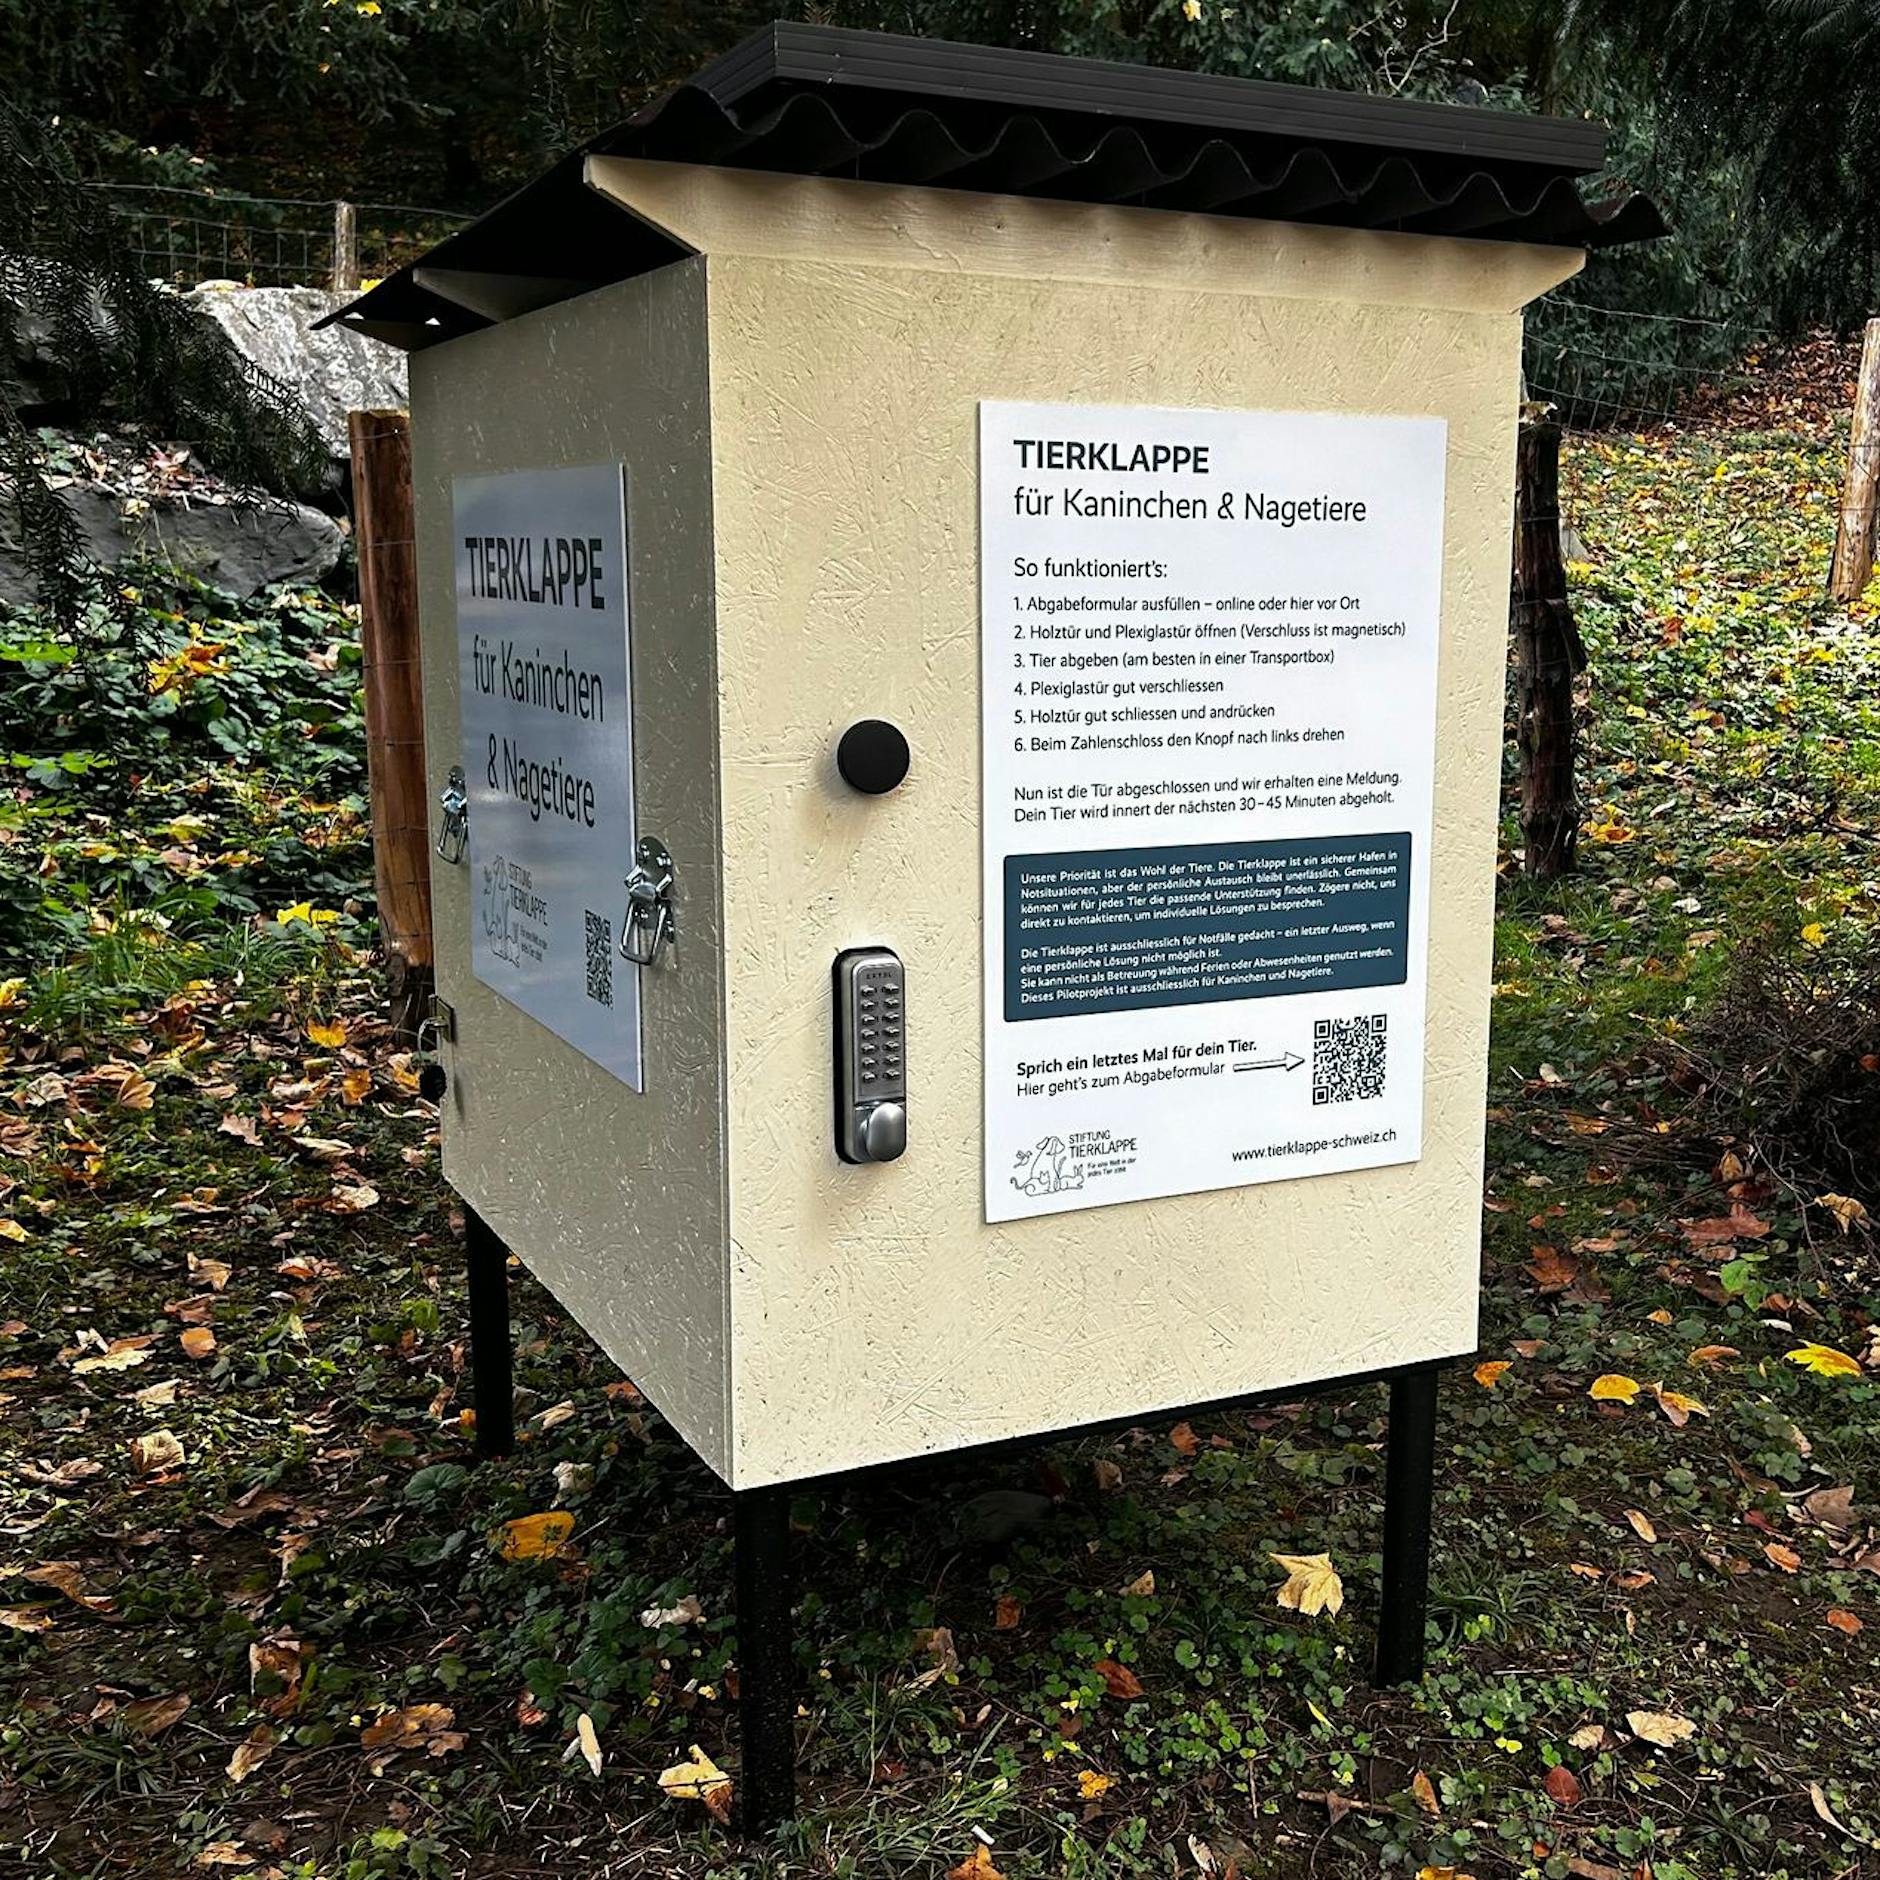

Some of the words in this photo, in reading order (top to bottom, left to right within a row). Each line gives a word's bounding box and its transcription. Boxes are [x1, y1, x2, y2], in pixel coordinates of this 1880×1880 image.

[1013, 439, 1209, 474] TIERKLAPPE
[1014, 485, 1053, 516] für
[1064, 488, 1206, 519] Kaninchen
[1217, 491, 1234, 519] &
[1245, 492, 1366, 527] Nagetiere
[465, 537, 605, 610] TIERKLAPPE
[1014, 557, 1038, 576] So
[1013, 596, 1023, 611] 1.
[1026, 595, 1137, 615] Abgabeformular
[1141, 595, 1200, 611] ausfüllen
[1215, 596, 1255, 610] online
[1258, 596, 1287, 610] oder
[1290, 596, 1314, 610] hier
[1316, 599, 1337, 610] vor
[1340, 596, 1360, 610] Ort
[1014, 624, 1025, 639] 2.
[1030, 624, 1081, 639] Holztür
[1085, 624, 1111, 639] und
[1115, 623, 1191, 642] Plexiglastür
[1194, 623, 1236, 638] öffnen
[1240, 623, 1310, 639] (Verschluss
[1313, 623, 1328, 636] ist
[1331, 621, 1405, 639] magnetisch)
[1013, 653, 1025, 668] 3.
[1029, 652, 1056, 667] Tier
[1060, 652, 1118, 670] abgeben
[1122, 652, 1148, 668] (am
[1152, 651, 1195, 666] besten
[1199, 652, 1211, 664] in
[1214, 651, 1246, 665] einer
[1249, 649, 1334, 666] Transportbox)
[473, 634, 497, 695] für
[501, 640, 604, 722] Kaninchen
[1014, 681, 1026, 695] 4.
[1030, 680, 1109, 698] Plexiglastür
[1112, 681, 1135, 698] gut
[1139, 678, 1223, 693] verschliessen
[1014, 709, 1026, 724] 5.
[1030, 708, 1081, 723] Holztür
[1084, 709, 1107, 726] gut
[1111, 706, 1176, 722] schliessen
[1181, 705, 1206, 719] und
[1209, 703, 1274, 718] andrücken
[1014, 737, 1026, 751] 6.
[1030, 736, 1066, 751] Beim
[1070, 733, 1163, 750] Zahlenschloss
[1167, 733, 1191, 747] den
[1195, 730, 1234, 747] Knopf
[1237, 729, 1267, 744] nach
[1271, 729, 1299, 742] links
[1302, 727, 1344, 742] drehen
[487, 733, 500, 790] &
[503, 737, 595, 828] Nagetiere
[1014, 786, 1043, 800] Nun
[1047, 786, 1063, 799] ist
[1067, 784, 1087, 799] die
[1090, 783, 1113, 797] Tür
[1116, 780, 1210, 799] abgeschlossen
[1214, 777, 1238, 792] und
[1241, 777, 1261, 790] wir
[1264, 774, 1314, 789] erhalten
[1317, 775, 1343, 787] eine
[1346, 771, 1402, 787] Meldung.
[1014, 807, 1046, 822] Dein
[1049, 806, 1076, 820] Tier
[1079, 804, 1108, 819] wird
[1112, 803, 1150, 816] innert
[1154, 801, 1175, 815] der
[1178, 799, 1235, 814] nächsten
[1285, 795, 1335, 808] Minuten
[1339, 790, 1394, 808] abgeholt.
[1021, 873, 1057, 884] Unsere
[1060, 869, 1101, 881] Priorität
[1104, 868, 1116, 878] ist
[1119, 867, 1137, 878] das
[1140, 864, 1166, 876] Wohl
[1169, 864, 1185, 874] der
[1218, 860, 1234, 871] Die
[1237, 858, 1286, 870] Tierklappe
[1289, 856, 1301, 866] ist
[1303, 855, 1318, 866] ein
[1320, 854, 1356, 864] sicherer
[1359, 851, 1386, 861] Hafen
[1388, 850, 1397, 859] in
[1101, 882, 1124, 894] aber
[1126, 881, 1143, 891] der
[1146, 877, 1201, 892] persönliche
[1204, 873, 1253, 886] Austausch
[1256, 871, 1282, 883] bleibt
[1344, 865, 1396, 876] Gemeinsam
[1021, 903, 1058, 914] können
[1061, 900, 1078, 911] wir
[1080, 898, 1095, 910] für
[1098, 897, 1124, 911] jedes
[1126, 895, 1147, 906] Tier
[1149, 894, 1165, 905] die
[1167, 891, 1211, 905] passende
[1214, 887, 1281, 900] Unterstützung
[1318, 882, 1350, 894] Zögere
[1380, 879, 1396, 888] uns
[1020, 917, 1051, 929] direkt
[1052, 918, 1065, 926] zu
[1134, 911, 1151, 920] um
[1153, 905, 1208, 919] individuelle
[1209, 904, 1255, 915] Lösungen
[1257, 903, 1269, 911] zu
[1021, 948, 1038, 959] Die
[1040, 944, 1094, 956] Tierklappe
[1095, 943, 1108, 953] ist
[1110, 936, 1180, 951] ausschliesslich
[1182, 935, 1197, 945] für
[1198, 932, 1236, 944] Notfälle
[1237, 929, 1275, 943] gedacht
[1284, 927, 1298, 937] ein
[1300, 926, 1330, 935] letzter
[1370, 920, 1395, 929] wenn
[1021, 992, 1054, 1003] Dieses
[1056, 985, 1114, 1000] Pilotprojekt
[1116, 984, 1128, 994] ist
[1130, 977, 1199, 993] ausschliesslich
[1201, 976, 1215, 986] für
[1217, 972, 1266, 984] Kaninchen
[1268, 969, 1286, 980] und
[1017, 1058, 1062, 1079] Sprich
[1066, 1056, 1087, 1070] ein
[1092, 1053, 1138, 1068] letztes
[1143, 1046, 1167, 1062] Mal
[1171, 1045, 1192, 1059] für
[1195, 1041, 1224, 1056] dein
[1227, 1039, 1256, 1052] Tier.
[1017, 1082, 1044, 1096] Hier
[1091, 1075, 1119, 1088] zum
[1122, 1061, 1225, 1086] Abgabeformular
[1069, 1129, 1111, 1144] STIFTUNG
[1069, 1137, 1137, 1158] TIERKLAPPE
[1232, 1128, 1396, 1162] www.tierklappe-schweiz.ch
